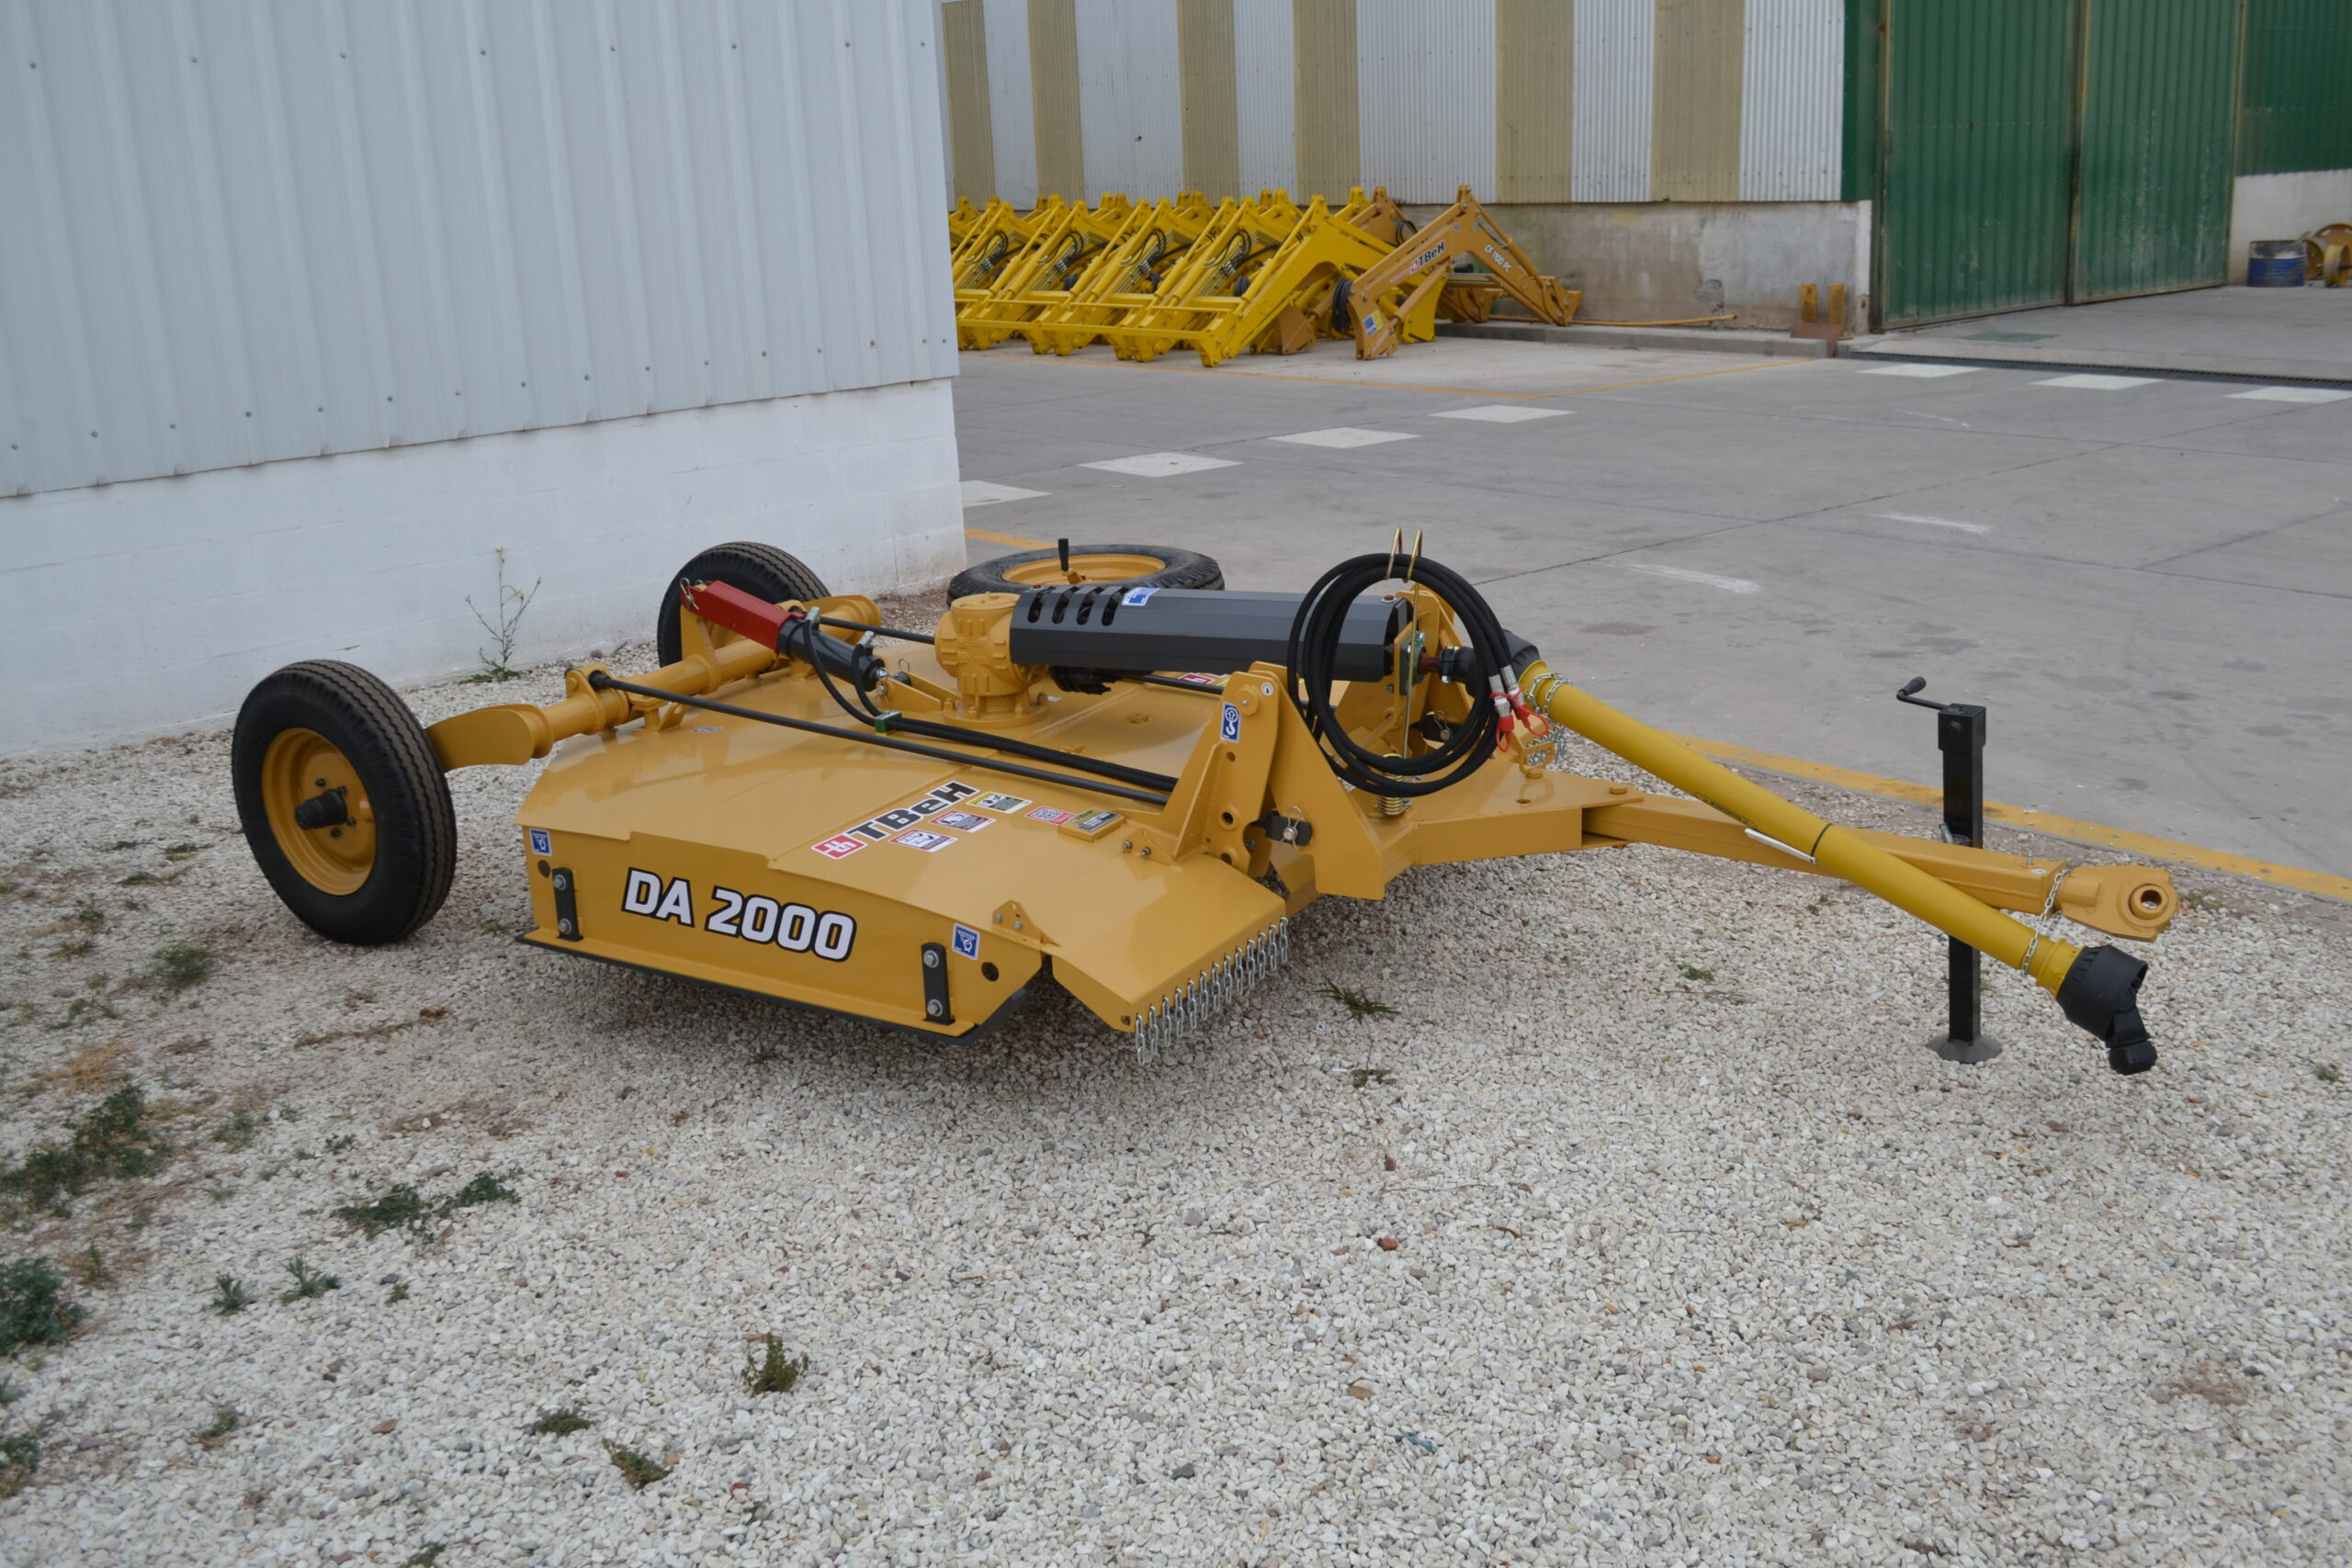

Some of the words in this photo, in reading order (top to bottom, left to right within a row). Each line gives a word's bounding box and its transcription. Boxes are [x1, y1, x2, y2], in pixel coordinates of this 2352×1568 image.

[1418, 241, 1445, 266] TBeH
[844, 782, 978, 840] TBeH
[621, 867, 695, 928] DA
[705, 886, 857, 963] 2000
